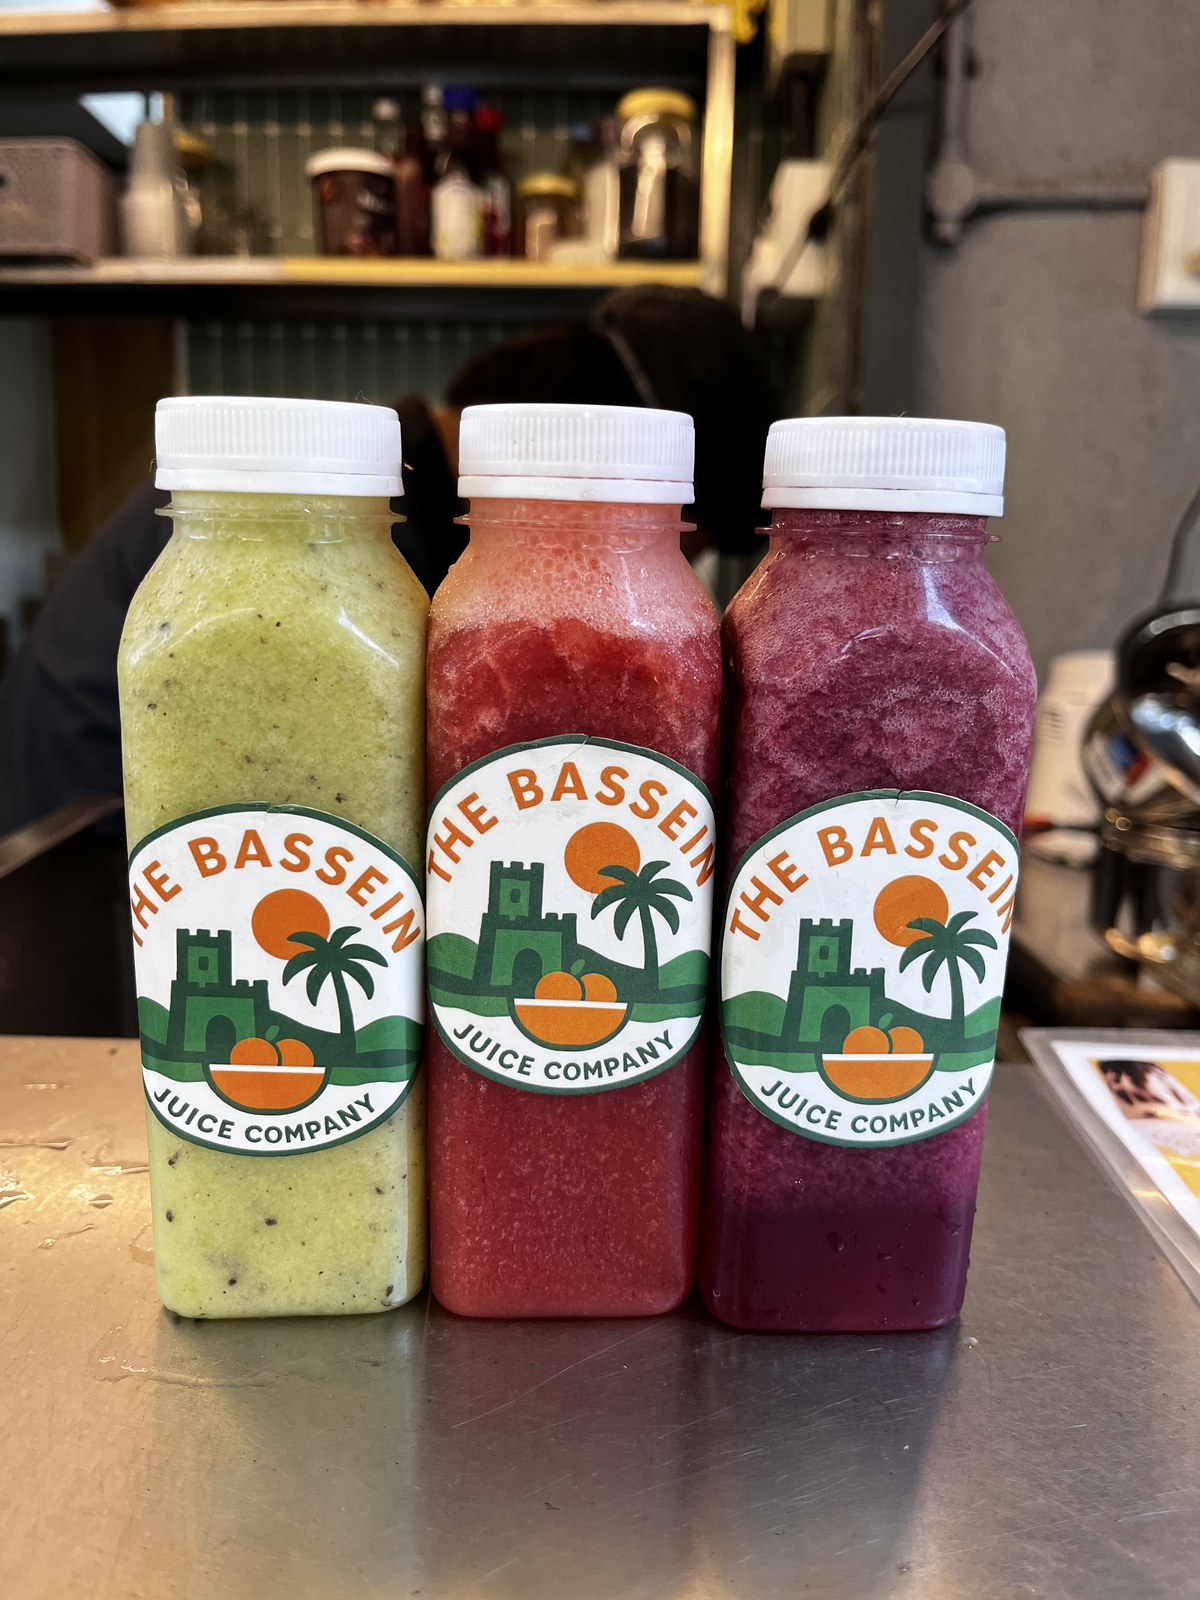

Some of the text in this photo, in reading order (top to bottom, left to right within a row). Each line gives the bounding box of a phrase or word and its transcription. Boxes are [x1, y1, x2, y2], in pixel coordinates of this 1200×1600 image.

[427, 761, 715, 887] THE BASSEIN
[187, 829, 421, 953] BASSEIN
[729, 850, 809, 941] THE
[453, 1023, 674, 1081] JUICE COMPANY
[153, 1088, 376, 1143] JUICE COMPANY
[760, 1077, 977, 1134] JUICE COMPANY
